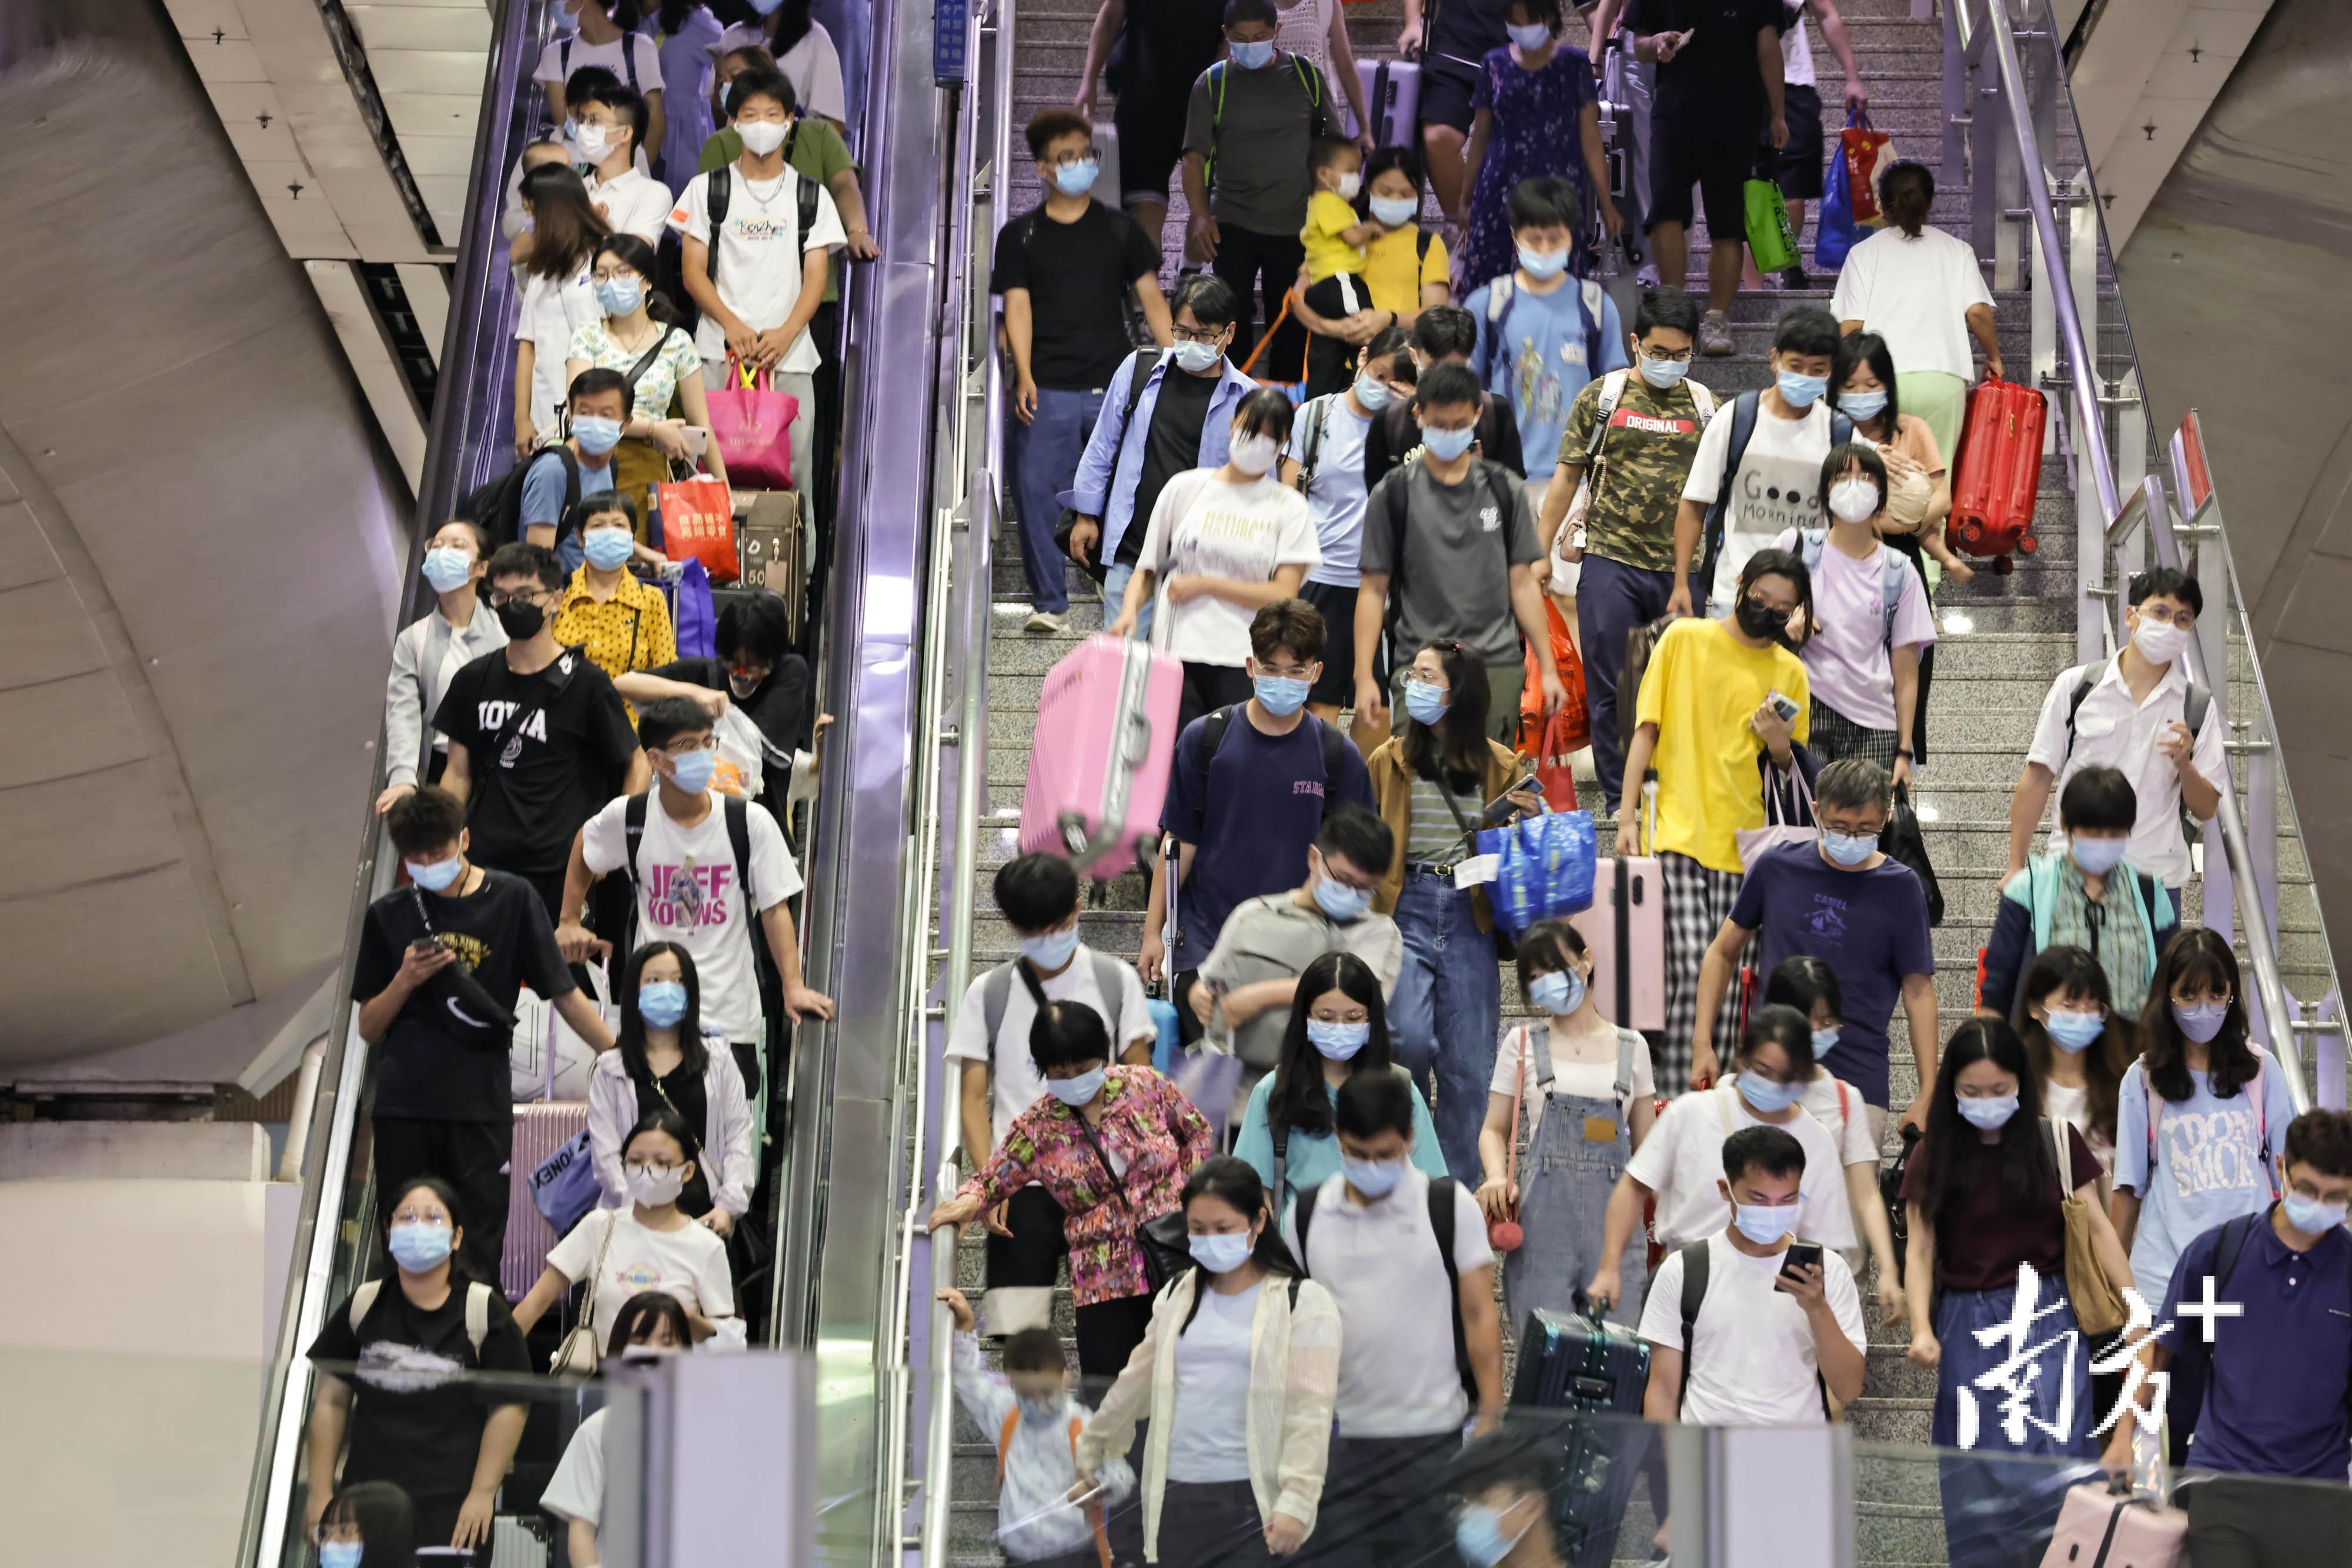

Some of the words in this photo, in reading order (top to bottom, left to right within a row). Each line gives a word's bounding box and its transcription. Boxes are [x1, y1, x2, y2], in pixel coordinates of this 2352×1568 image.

[1626, 414, 1680, 433] ORIGINAL
[649, 900, 727, 926] KONS
[1814, 893, 1847, 911] CAMEL
[534, 1146, 574, 1189] YONEX
